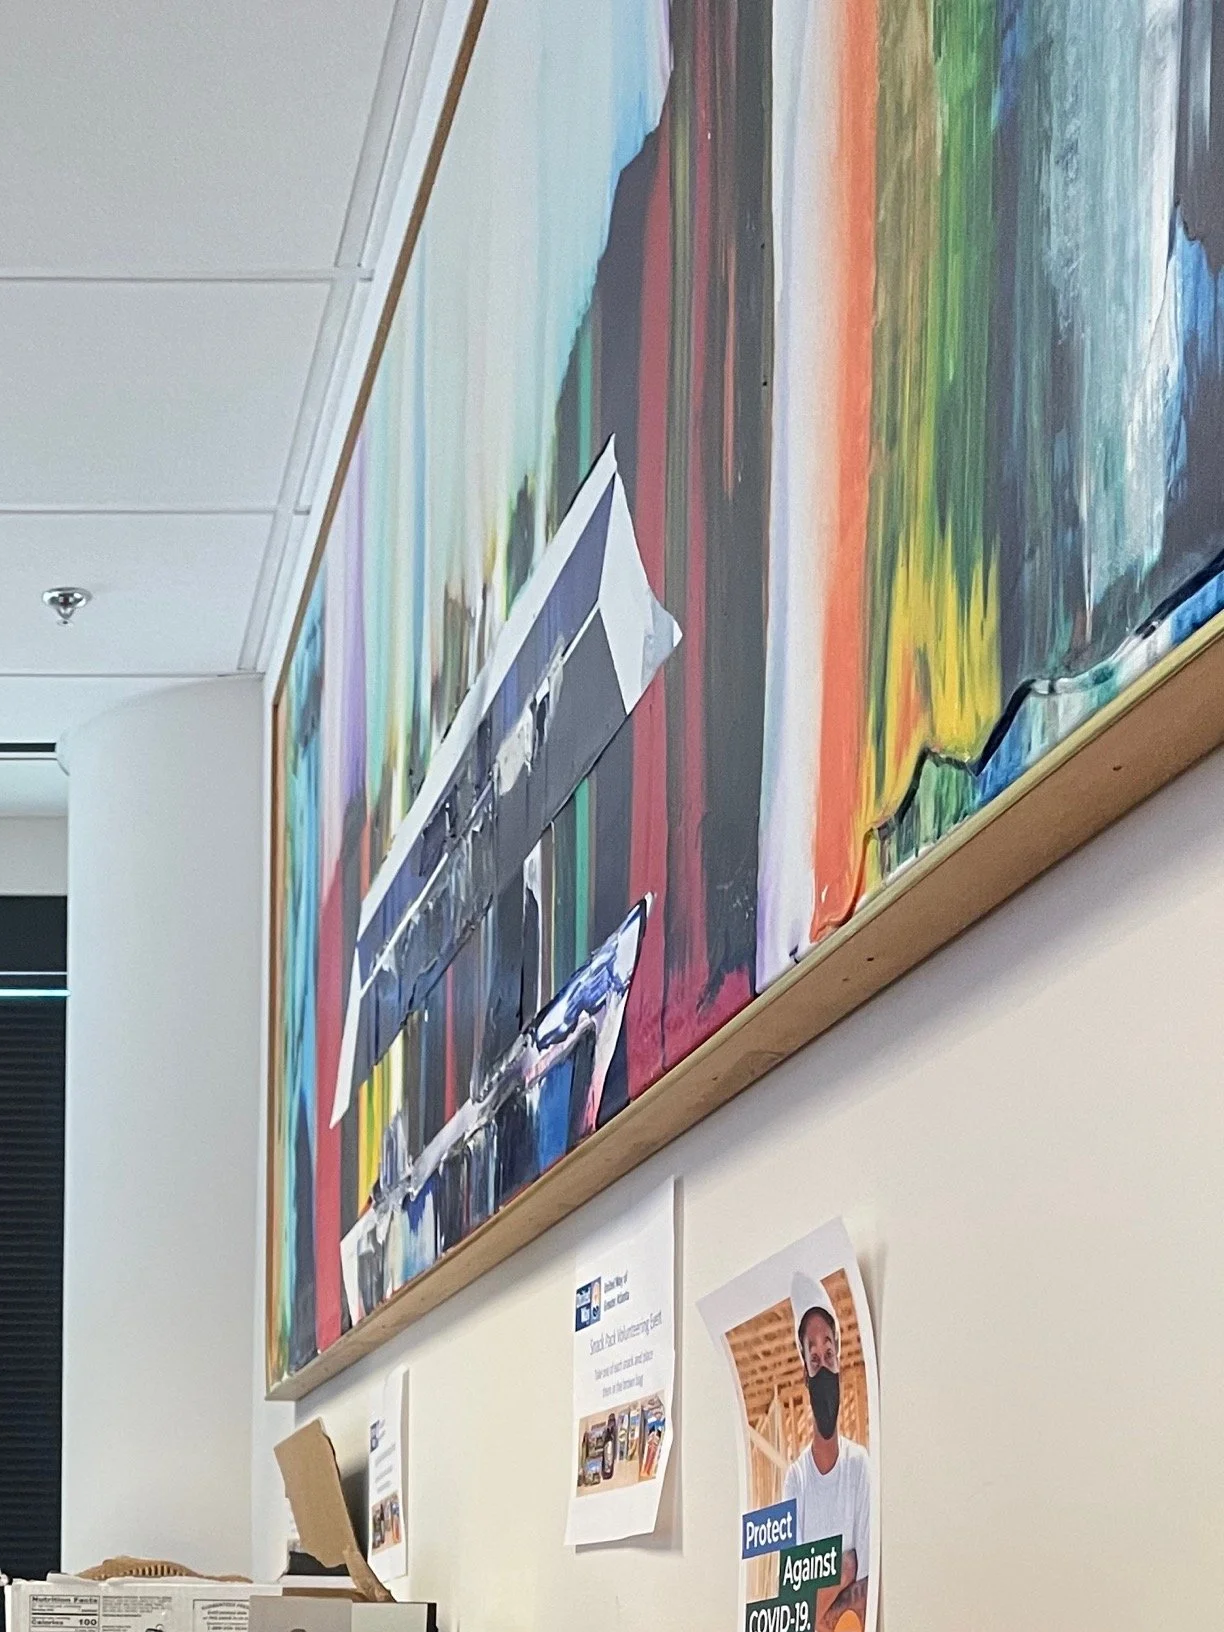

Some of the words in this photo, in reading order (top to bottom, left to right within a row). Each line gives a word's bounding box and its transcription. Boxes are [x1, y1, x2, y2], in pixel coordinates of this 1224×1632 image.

[590, 1333, 604, 1355] Snack
[605, 1329, 616, 1347] Pack
[617, 1318, 650, 1342] Volunteering
[650, 1310, 662, 1330] Event
[746, 1511, 792, 1550] Protect
[782, 1547, 836, 1591] Against
[79, 1618, 97, 1626] 100
